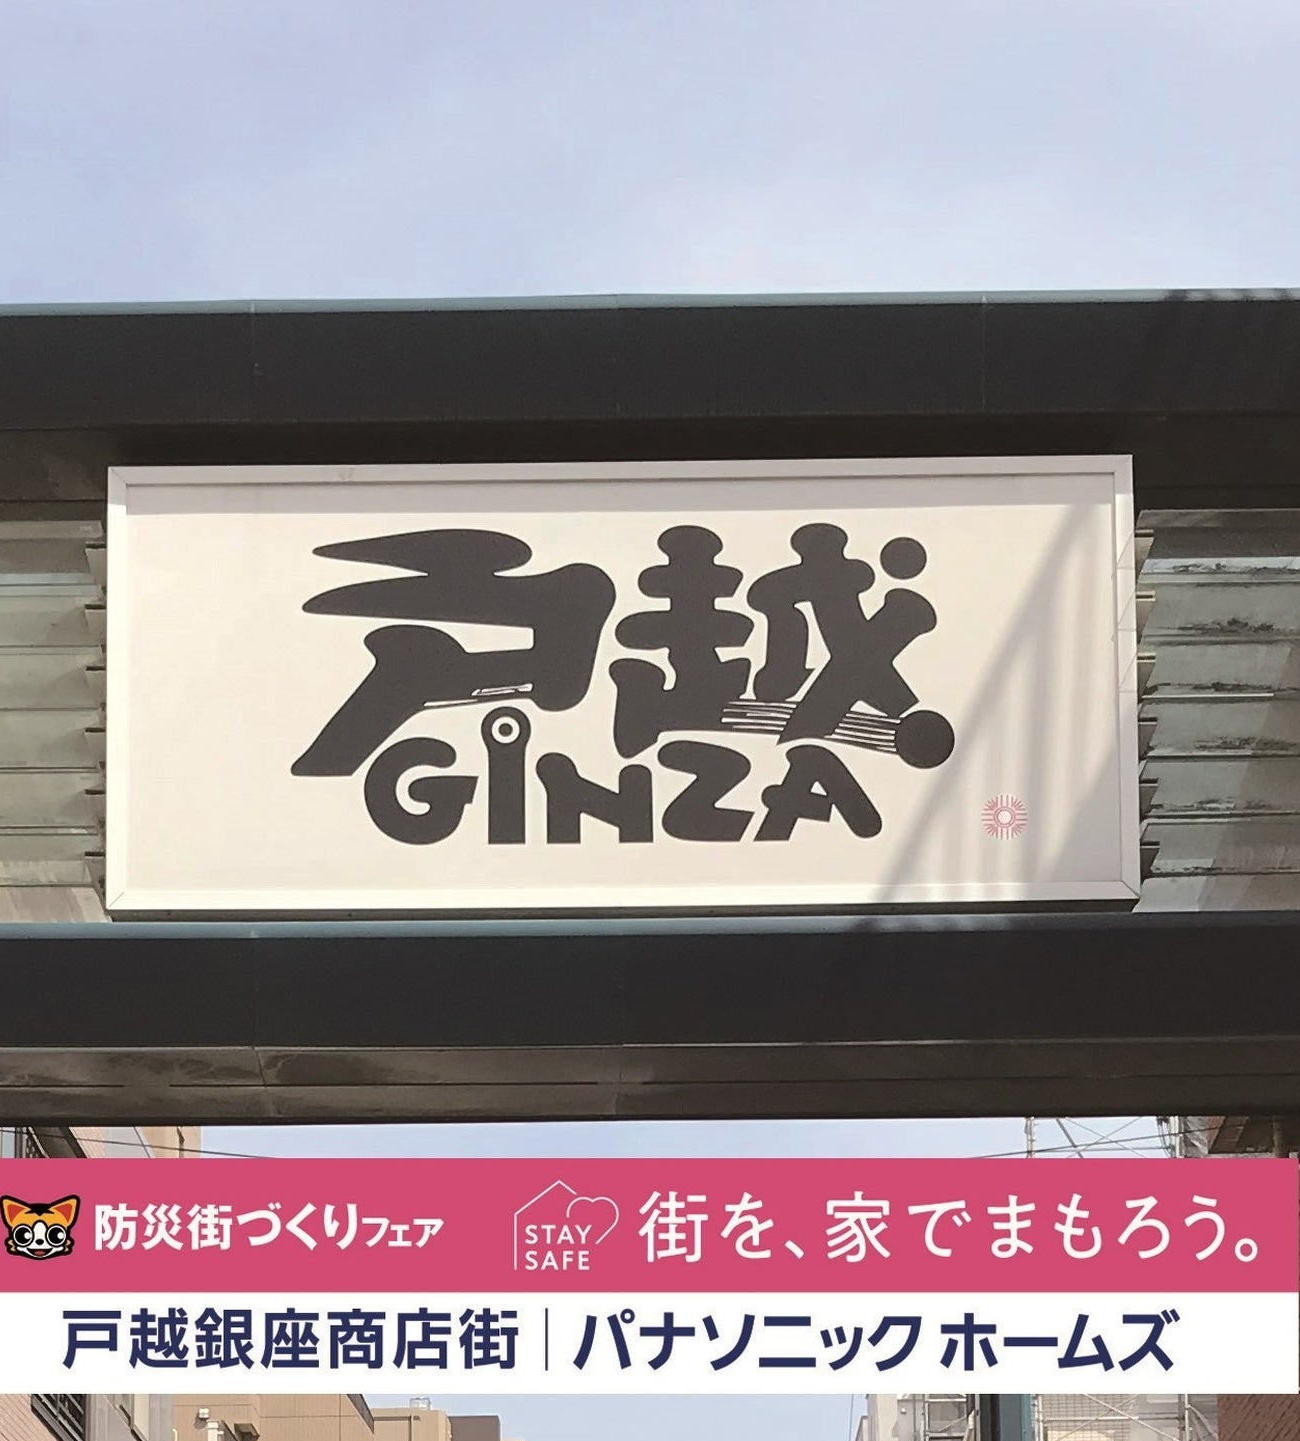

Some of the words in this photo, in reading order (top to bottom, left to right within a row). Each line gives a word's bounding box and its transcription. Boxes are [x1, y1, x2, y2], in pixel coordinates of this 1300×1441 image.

[290, 523, 955, 777] 戸越
[95, 1203, 445, 1252] 防災街づくりフェア
[525, 1222, 593, 1245] STAY
[638, 1189, 1260, 1263] 街を、家でまもろう。
[525, 1250, 590, 1272] SAFE
[62, 1307, 517, 1371] 戸越銀座商店街
[574, 1307, 922, 1371] パナソニック
[940, 1304, 1181, 1371] ホームズ
